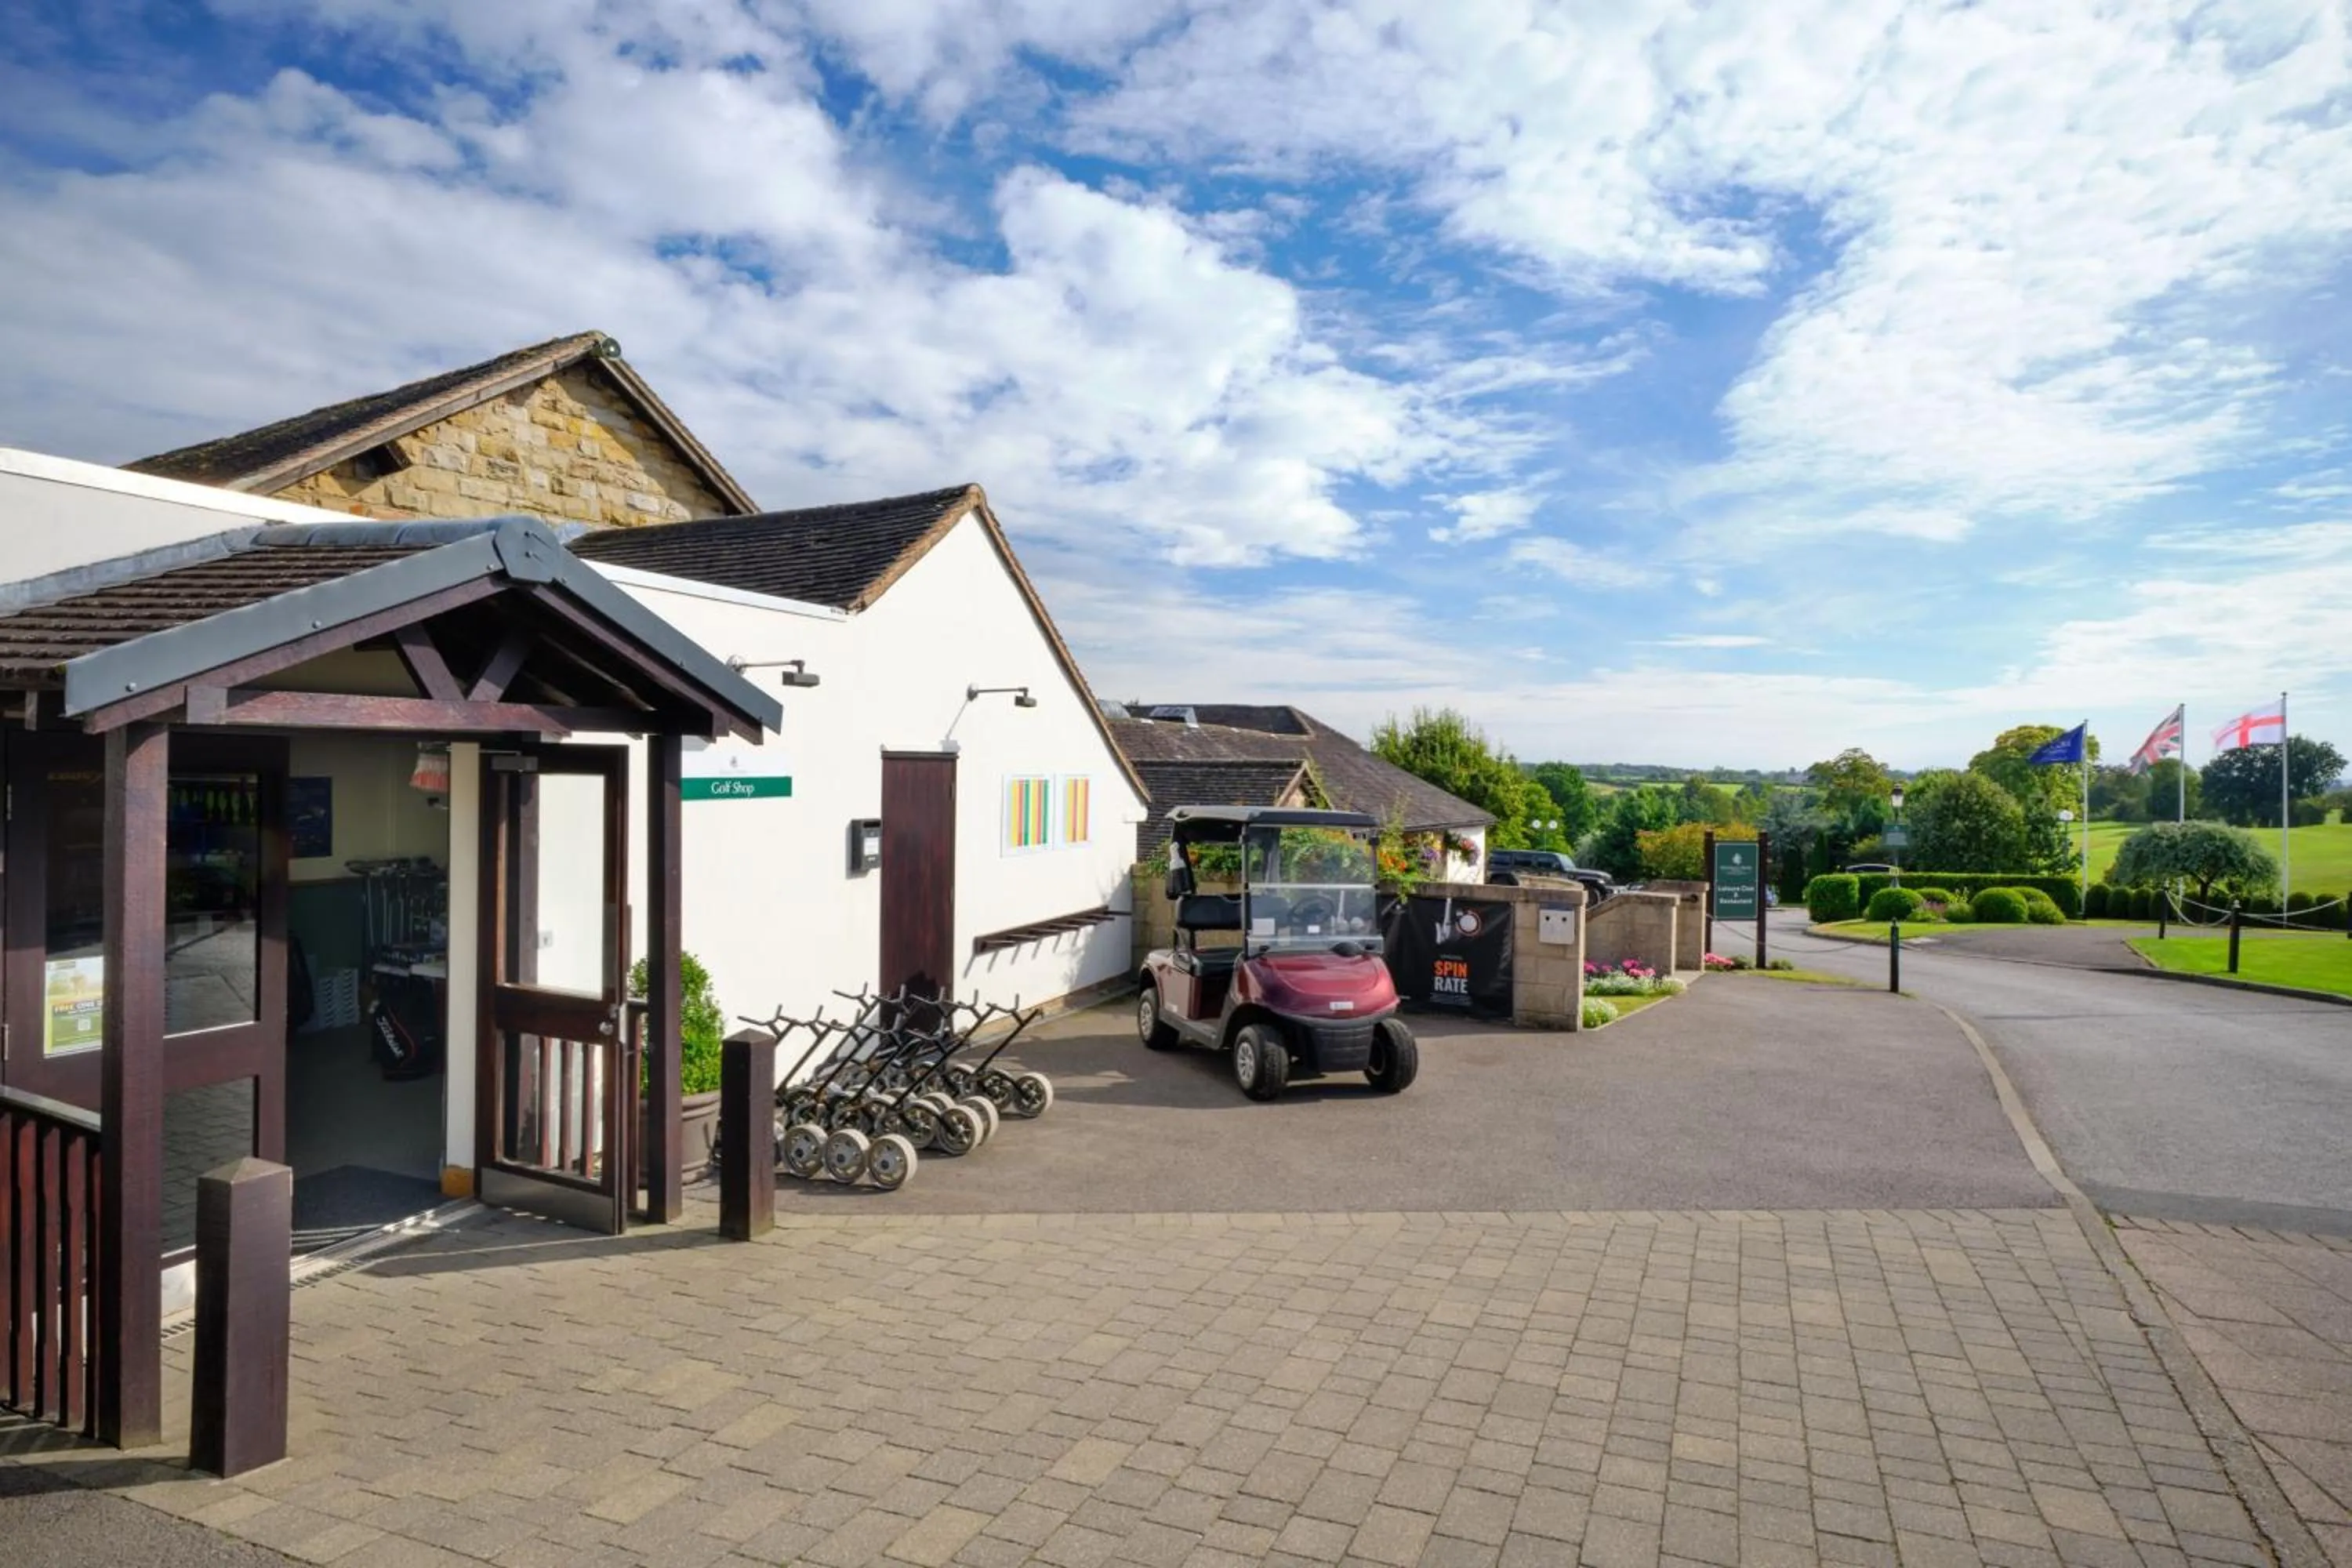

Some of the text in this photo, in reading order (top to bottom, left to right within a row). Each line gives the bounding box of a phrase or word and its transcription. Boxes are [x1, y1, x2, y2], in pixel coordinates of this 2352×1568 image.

[710, 781, 754, 797] Golf Shop
[1433, 960, 1468, 978] SPIN
[1434, 976, 1468, 993] RATE
